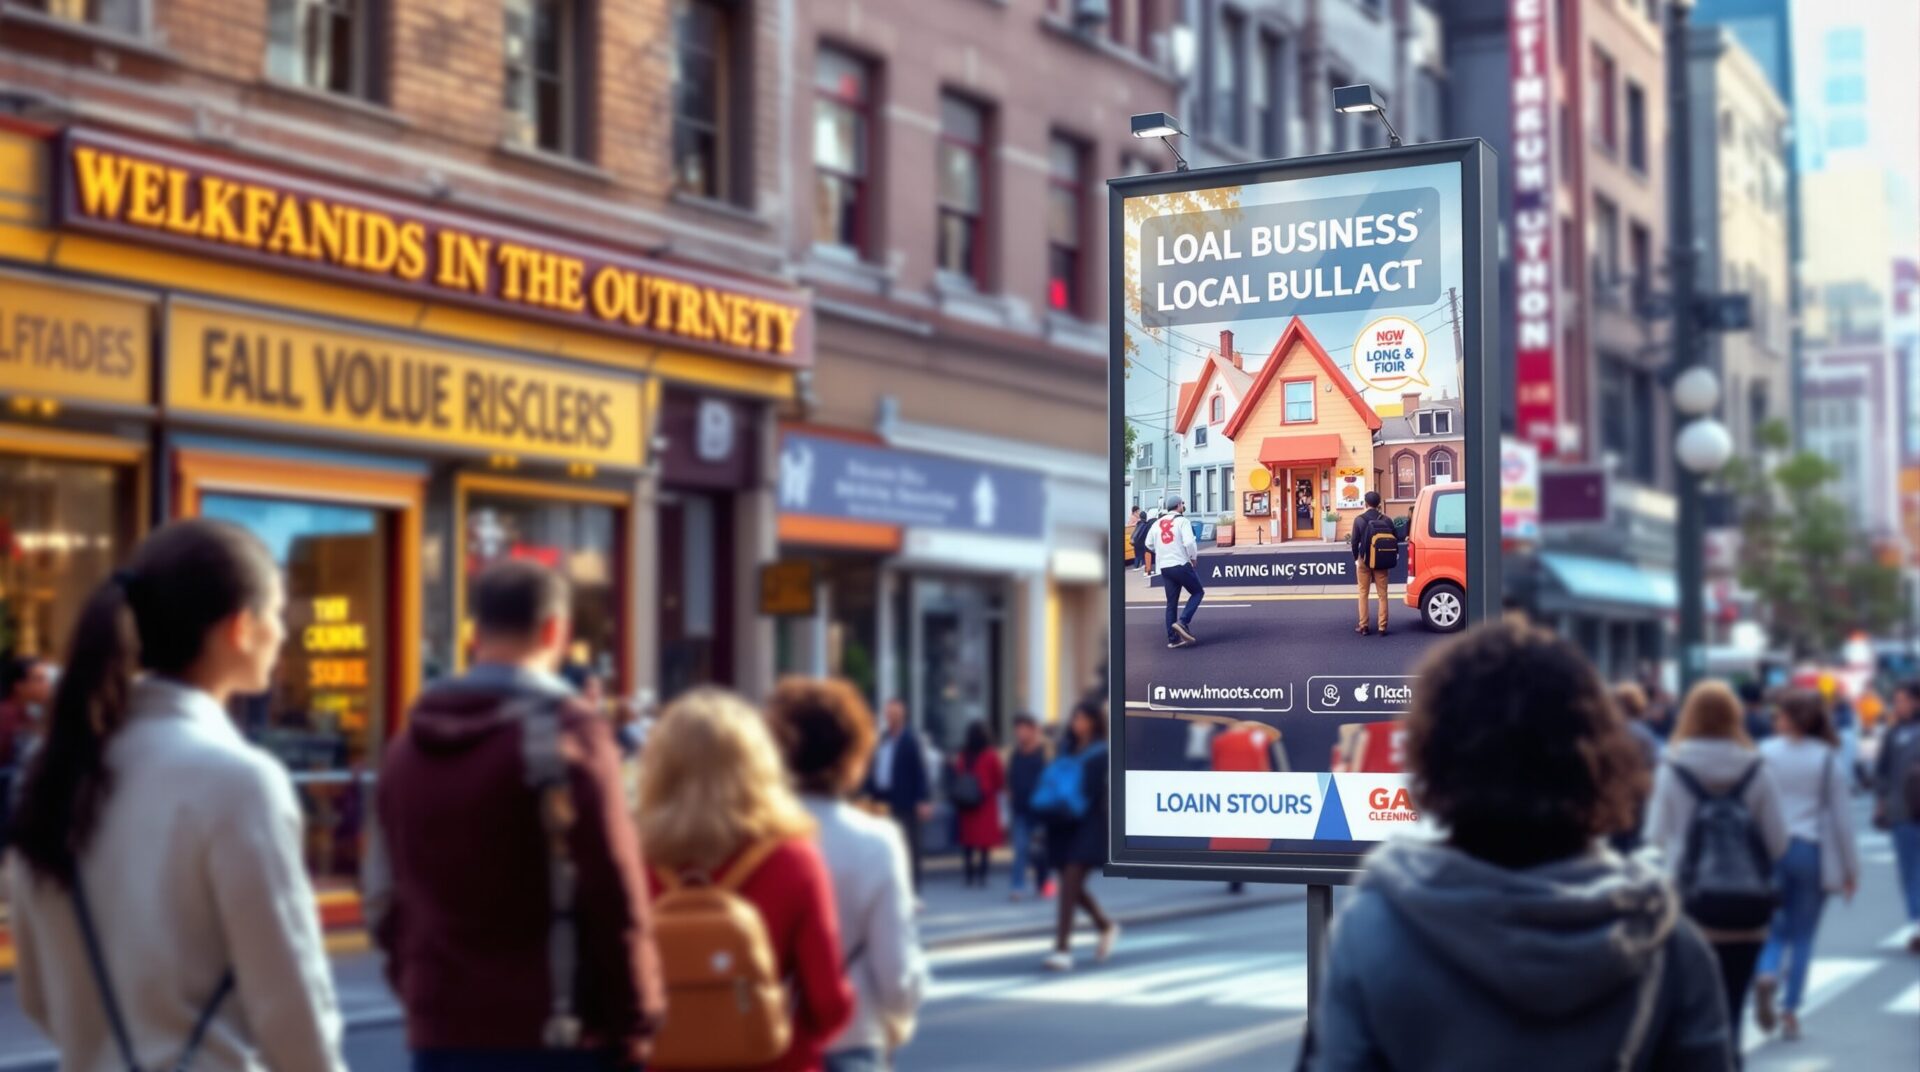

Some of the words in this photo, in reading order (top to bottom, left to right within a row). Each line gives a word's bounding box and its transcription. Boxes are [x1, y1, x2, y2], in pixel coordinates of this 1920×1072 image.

[76, 149, 427, 280] WELKFANIDS
[437, 230, 489, 292] IN
[499, 245, 586, 312] THE
[593, 267, 803, 354] OUTRNETY
[1157, 230, 1241, 266] LOAL
[1251, 210, 1419, 258] BUSINESS
[1157, 274, 1260, 312] LOCAL
[1268, 259, 1422, 302] BULLACT
[1366, 349, 1401, 362] LONG
[1404, 347, 1414, 359] &
[202, 327, 304, 409] FALL
[314, 344, 450, 427] VOLUE
[1212, 565, 1222, 578] A
[1224, 564, 1269, 577] RIVING
[1299, 562, 1346, 575] STONE
[1156, 792, 1221, 813] LOAIN
[1227, 793, 1313, 815] STOURS
[1368, 811, 1418, 822] CLEENING
